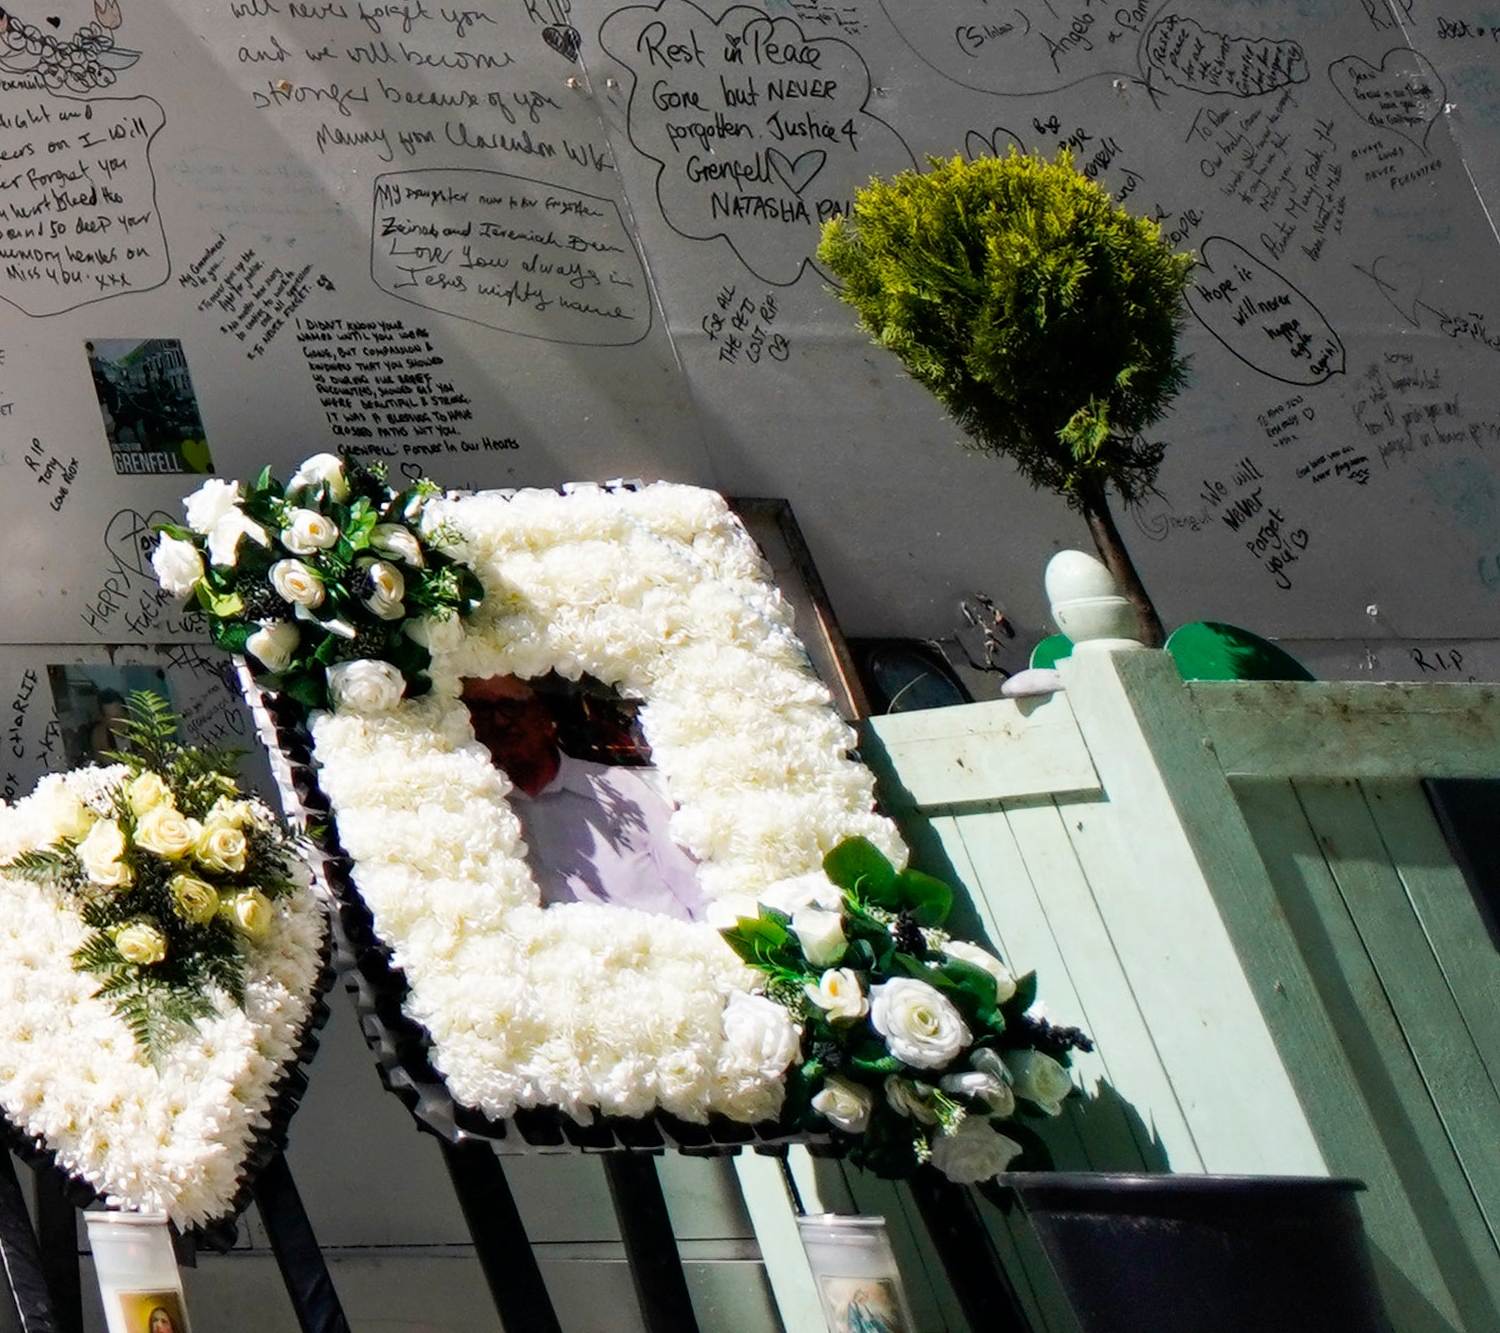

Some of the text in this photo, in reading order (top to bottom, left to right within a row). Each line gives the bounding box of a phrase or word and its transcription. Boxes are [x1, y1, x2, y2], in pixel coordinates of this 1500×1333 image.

[638, 17, 821, 69] Rest in Peace
[652, 75, 837, 112] Gone but NEVER
[767, 112, 840, 143] Justice
[841, 118, 858, 152] 4
[687, 149, 775, 195] Grenfell
[711, 193, 810, 224] NATASHA
[113, 453, 184, 473] GRENFELL
